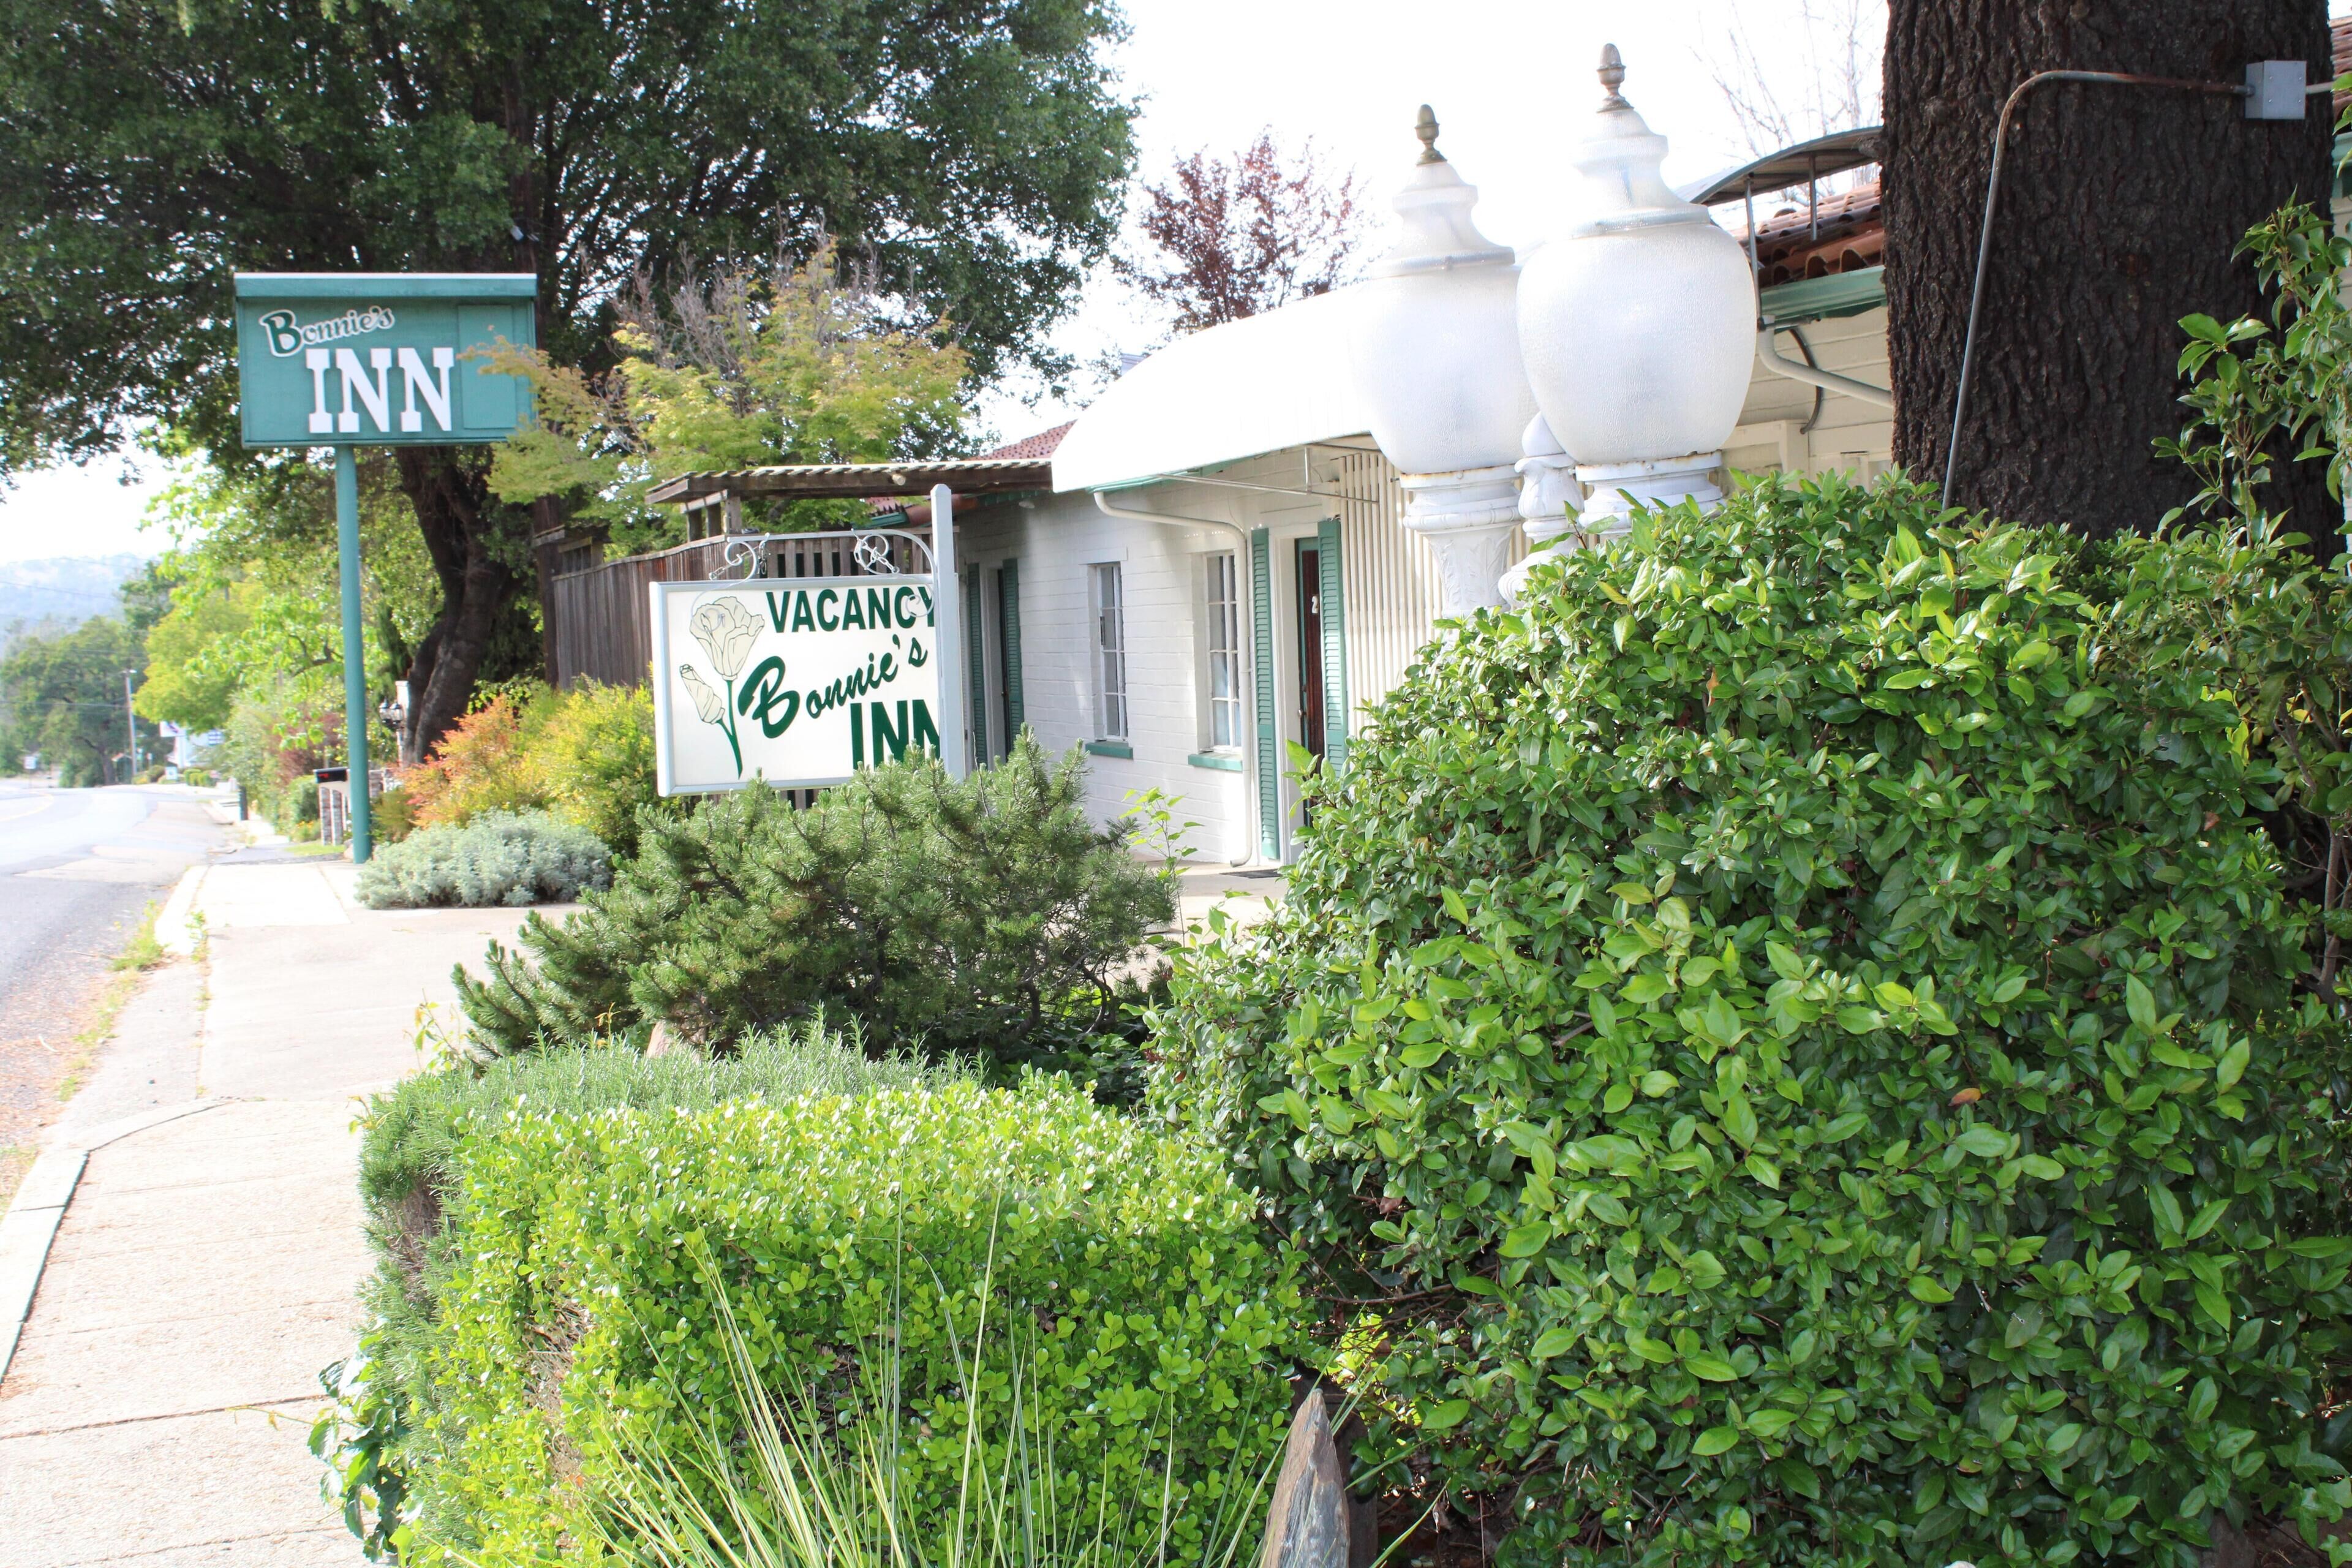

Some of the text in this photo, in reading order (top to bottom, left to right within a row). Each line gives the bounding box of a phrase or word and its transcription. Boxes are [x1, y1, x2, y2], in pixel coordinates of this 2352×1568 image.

[259, 306, 395, 356] Bonnie's
[306, 347, 454, 434] INN
[766, 586, 935, 633] VACANCY
[1312, 595, 1319, 614] 2
[737, 634, 928, 739] Bonnie's
